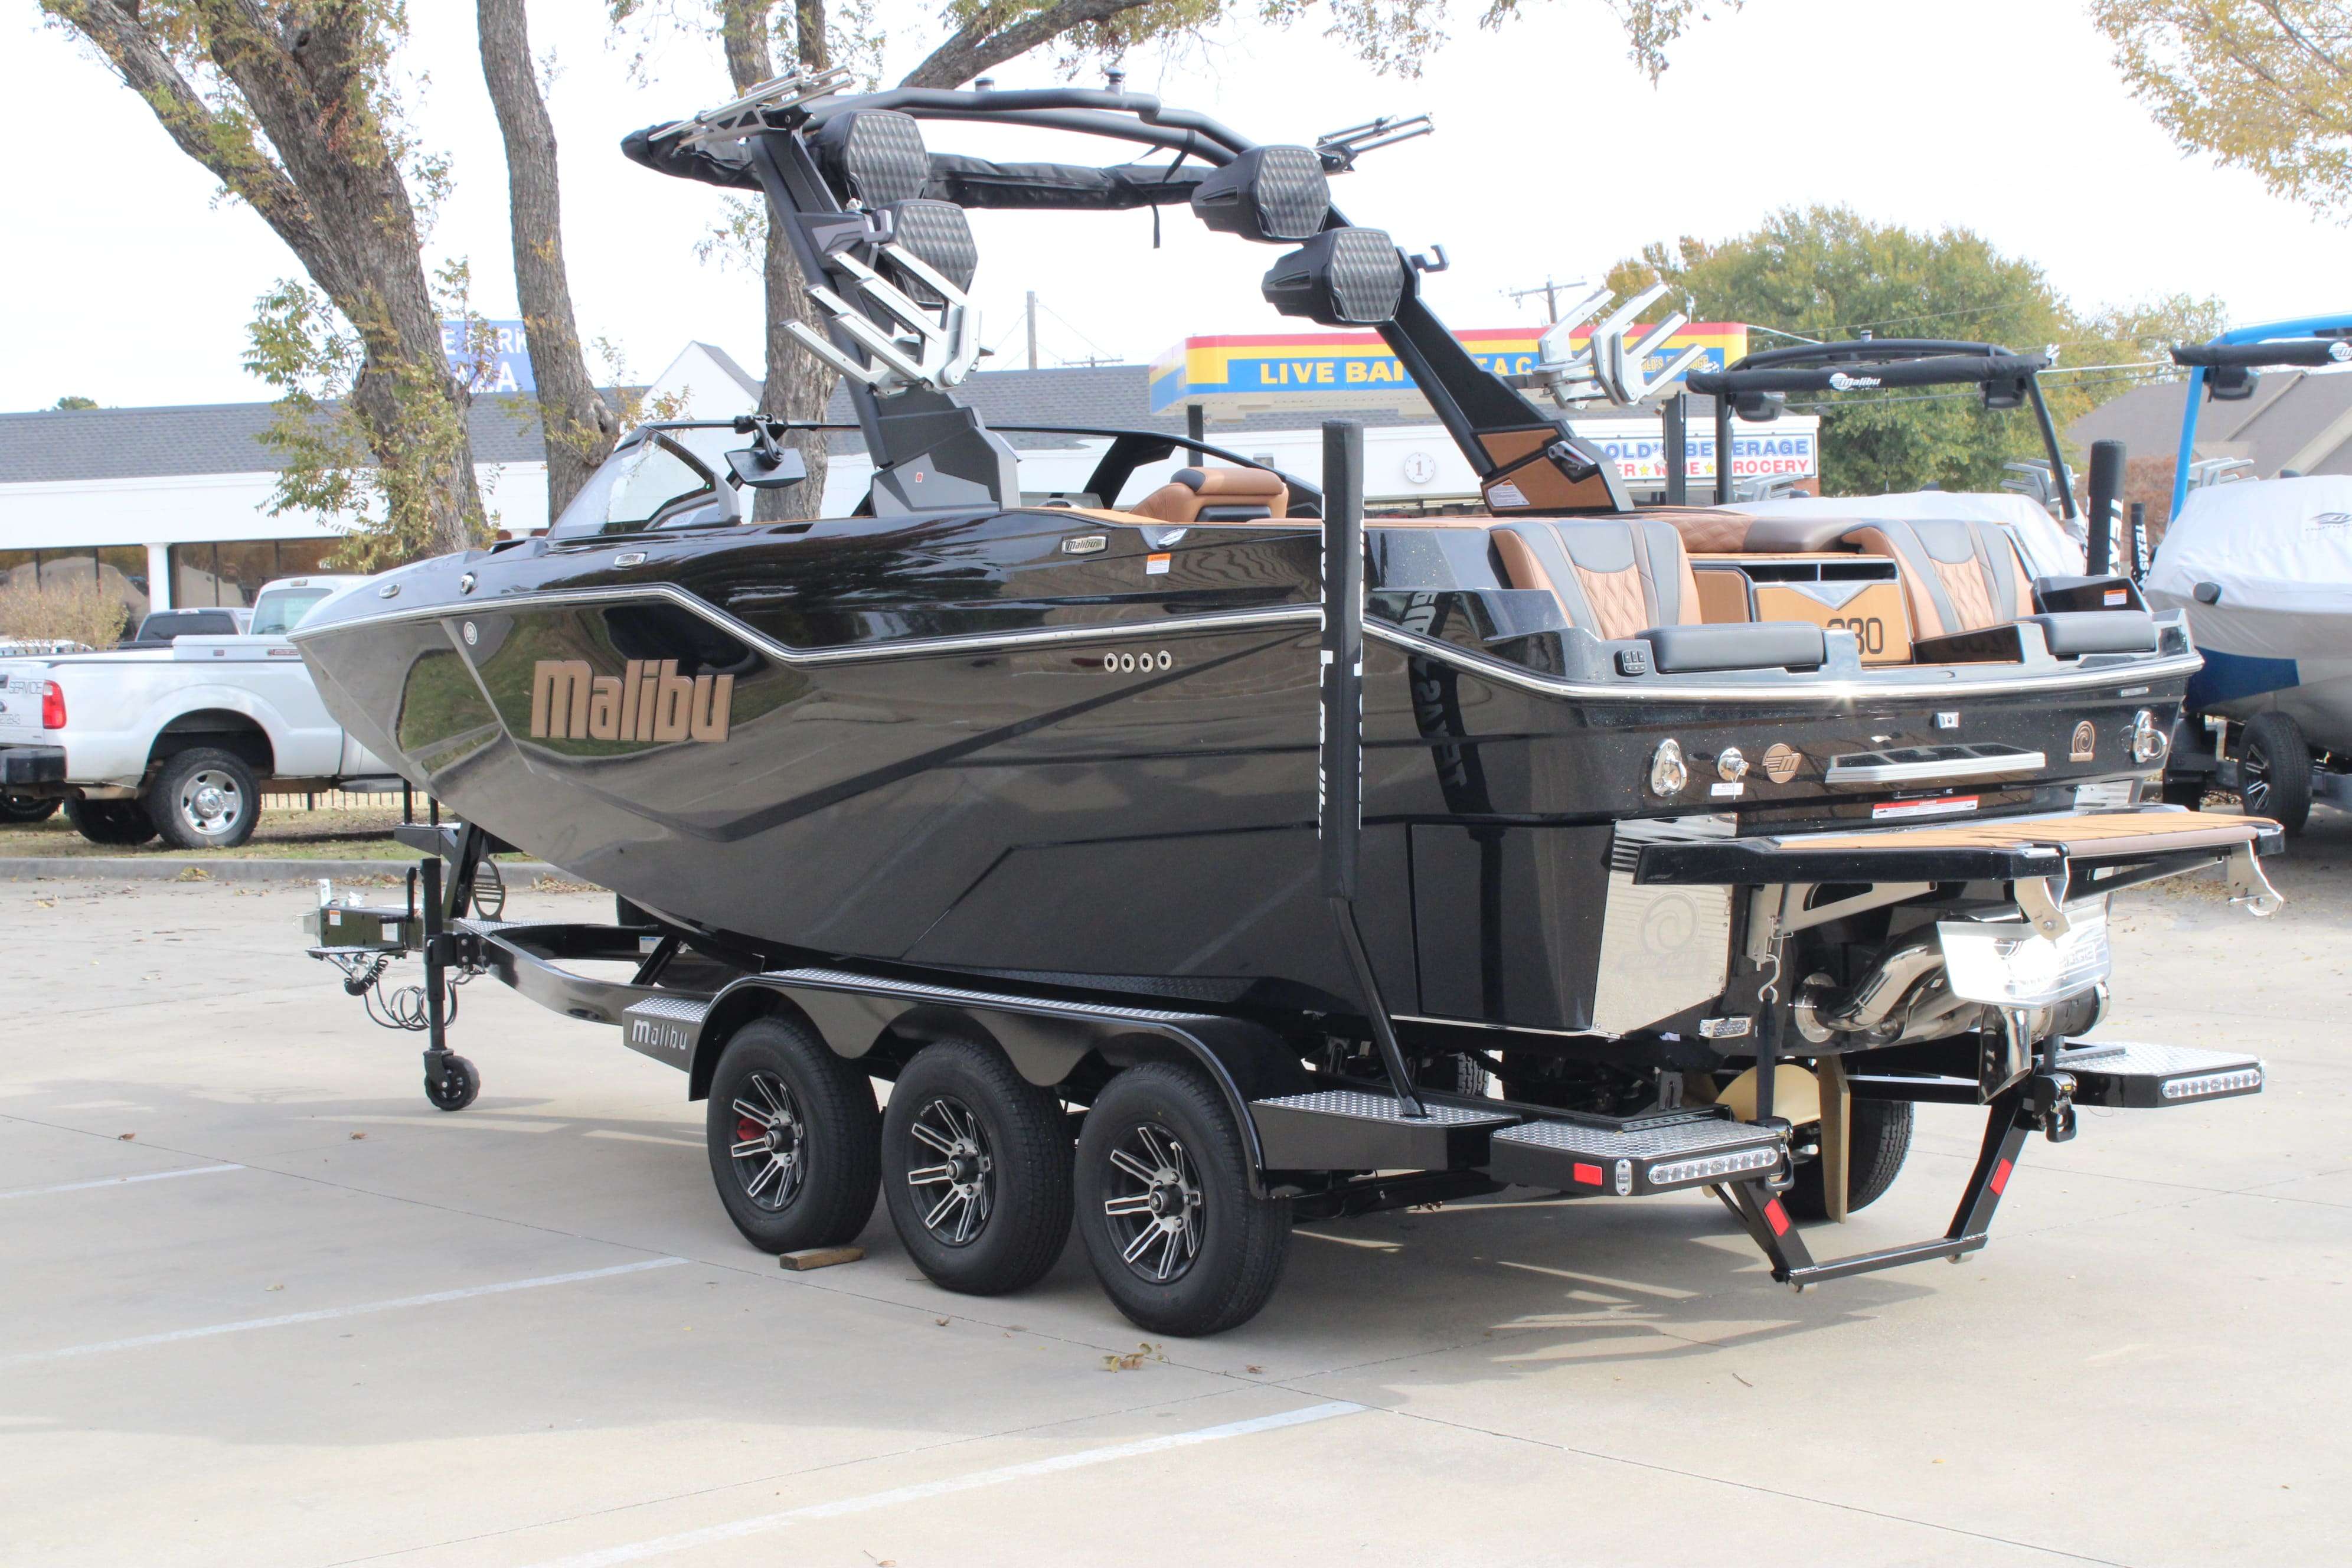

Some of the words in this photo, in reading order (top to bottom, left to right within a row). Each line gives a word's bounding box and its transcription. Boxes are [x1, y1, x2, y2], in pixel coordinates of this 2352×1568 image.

[1260, 362, 1335, 384] LIVE
[1345, 360, 1404, 383] BAI
[1840, 377, 1881, 386] Malibu
[1596, 442, 1668, 459] OLD'
[1685, 439, 1809, 458] BEERAGE
[1416, 460, 1423, 476] 1
[1654, 462, 1700, 476] WE
[1732, 459, 1808, 473] ROCERY
[1067, 540, 1096, 551] Malibu
[2135, 524, 2150, 571] TEXAS
[1827, 618, 1883, 655] 30
[9, 681, 43, 694] SERVICE
[531, 659, 735, 742] Malibu
[632, 1019, 687, 1050] Malibu
